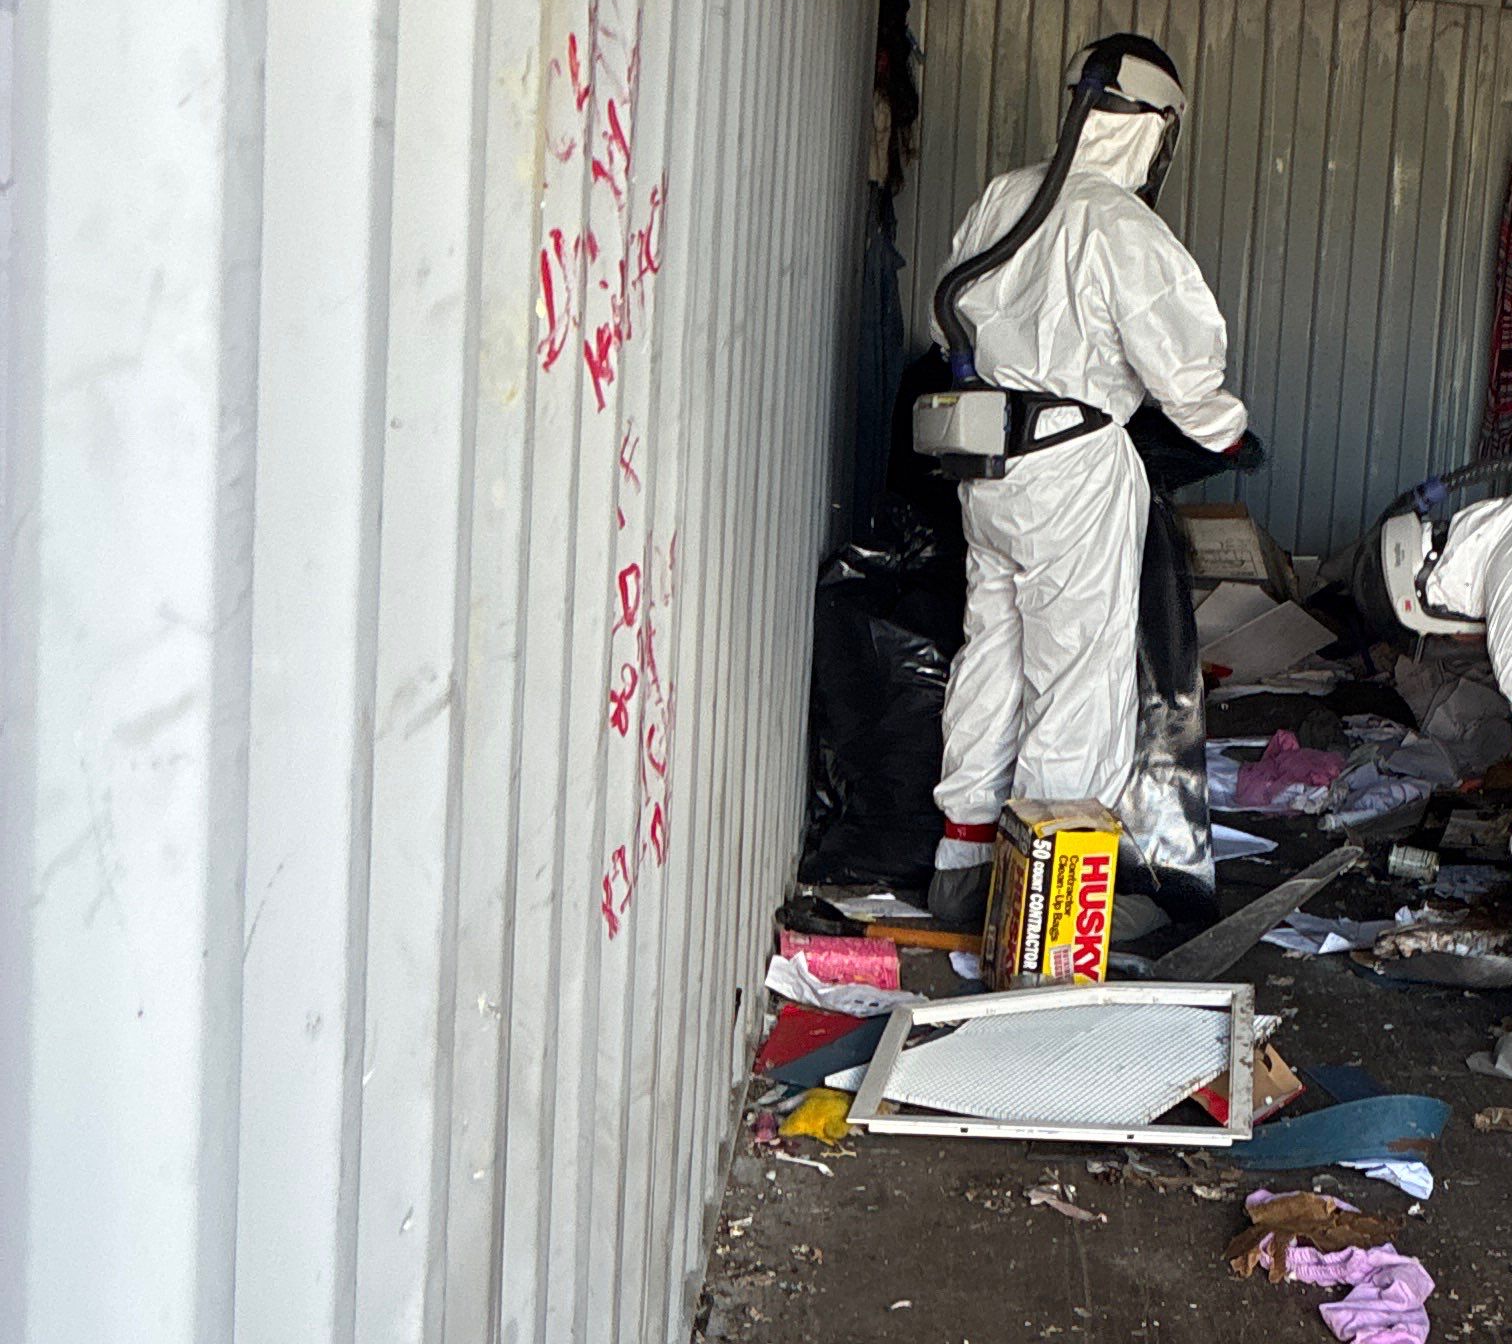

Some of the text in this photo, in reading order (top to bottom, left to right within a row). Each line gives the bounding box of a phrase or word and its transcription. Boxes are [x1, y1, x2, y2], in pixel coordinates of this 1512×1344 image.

[1023, 838, 1052, 970] 50 COUNT CONTRACTOR
[1049, 854, 1069, 942] Clean-Up Bags
[1064, 854, 1079, 917] Contractor
[1073, 855, 1111, 983] HUSKY
